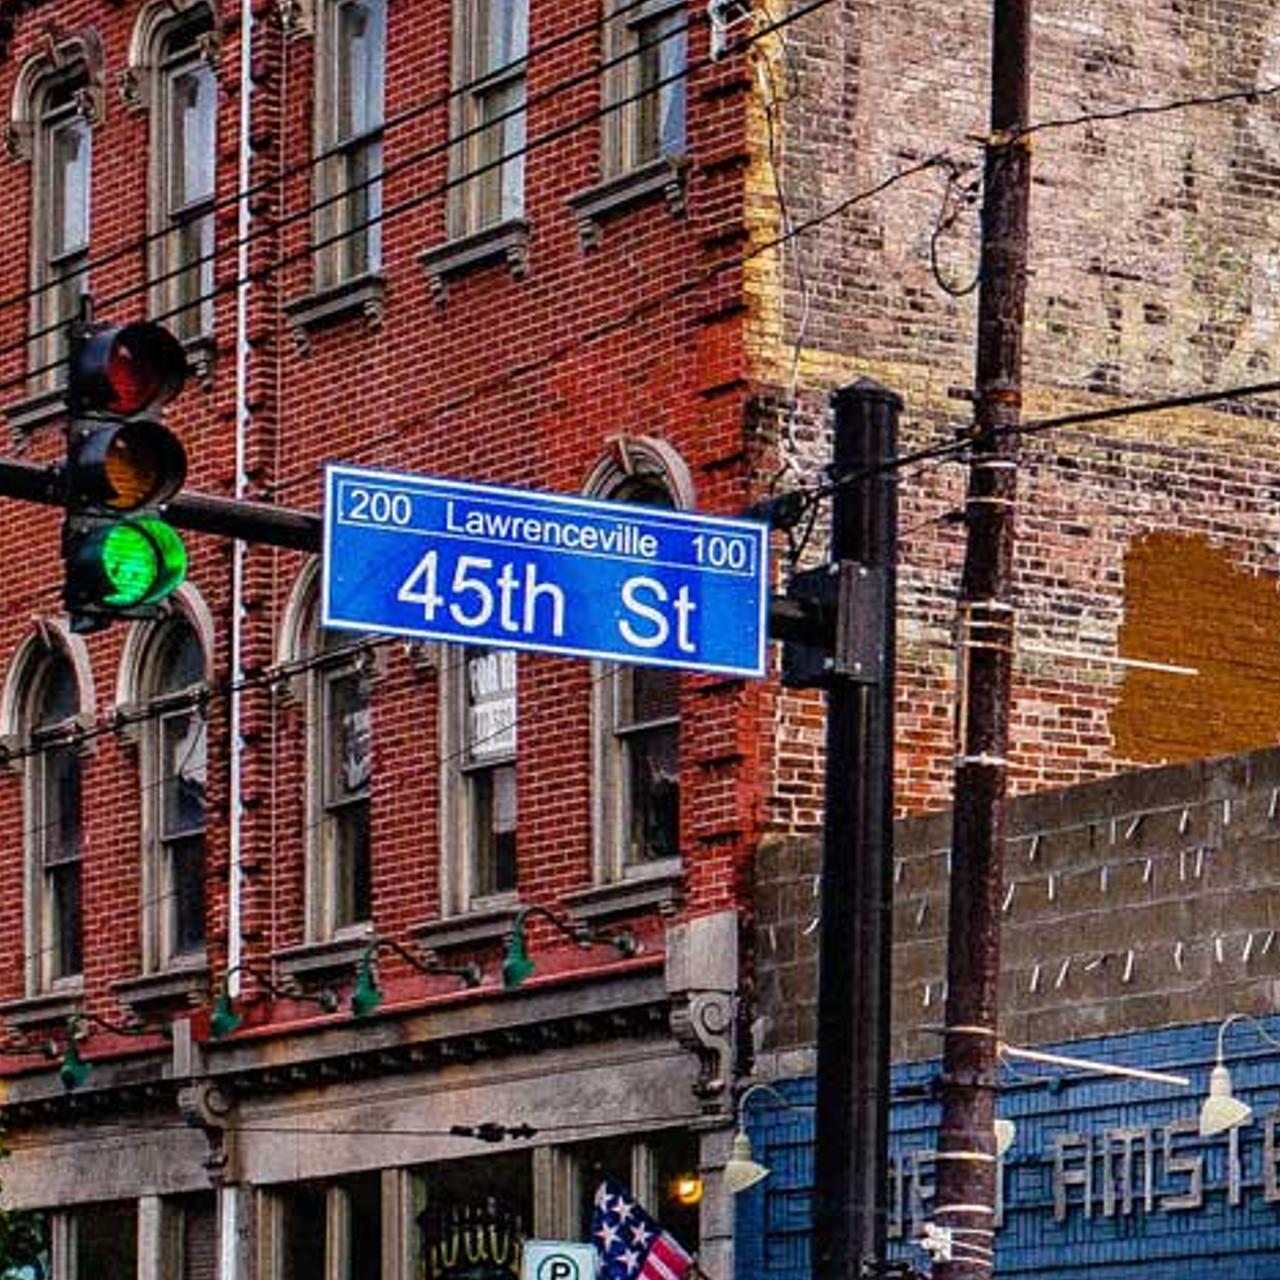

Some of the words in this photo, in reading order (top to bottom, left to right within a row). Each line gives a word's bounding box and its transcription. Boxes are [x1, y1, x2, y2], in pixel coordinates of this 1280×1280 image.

[349, 490, 412, 525] 200
[446, 501, 659, 557] Lawrenceville
[692, 536, 747, 570] 100
[397, 550, 565, 637] 45th
[618, 576, 697, 653] St
